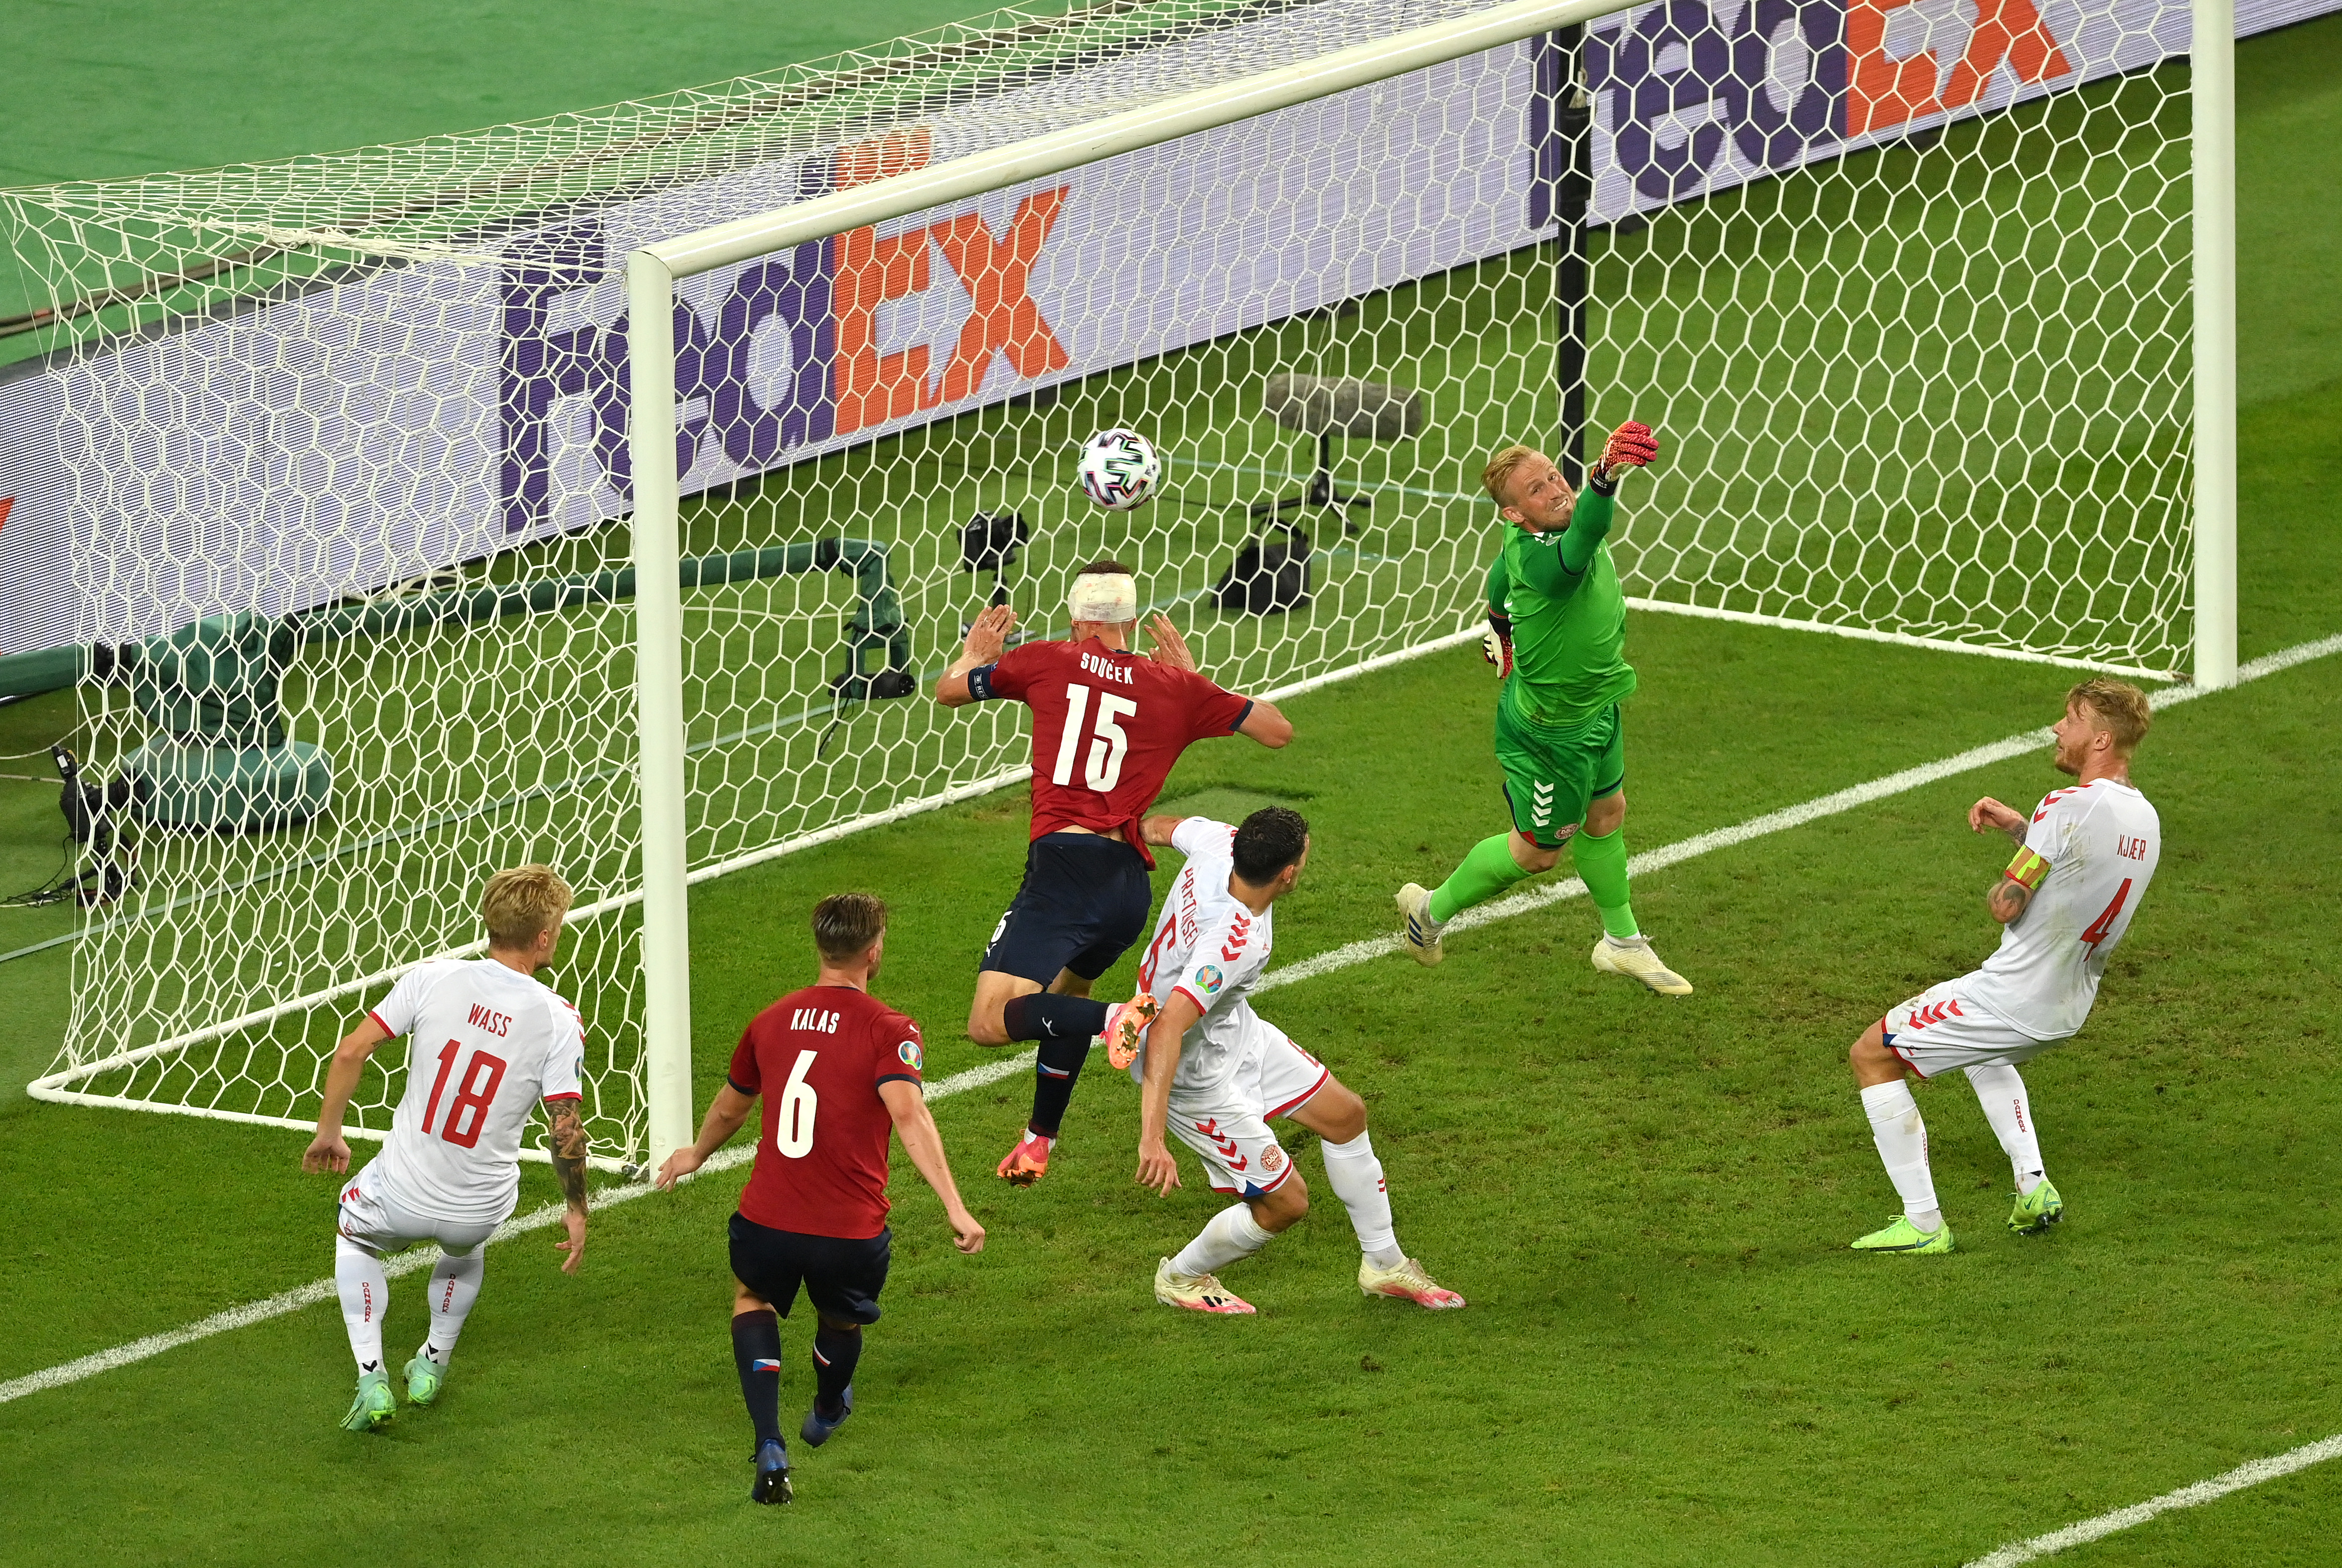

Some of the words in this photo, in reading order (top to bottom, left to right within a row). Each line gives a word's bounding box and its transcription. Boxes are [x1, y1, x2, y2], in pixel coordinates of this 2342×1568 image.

[1081, 652, 1133, 685] SOUČEK
[1052, 683, 1137, 792] 15
[2117, 834, 2146, 861] KJÆR
[2079, 878, 2132, 962] 4
[468, 1003, 512, 1037] WASS
[790, 1008, 840, 1034] KALAS
[421, 1038, 507, 1148] 18
[777, 1049, 818, 1158] 6
[2014, 1099, 2027, 1133] DANMARK
[1265, 1150, 1278, 1165] DBU
[362, 1282, 371, 1322] DANMARK
[442, 1274, 456, 1313] DANMARK
